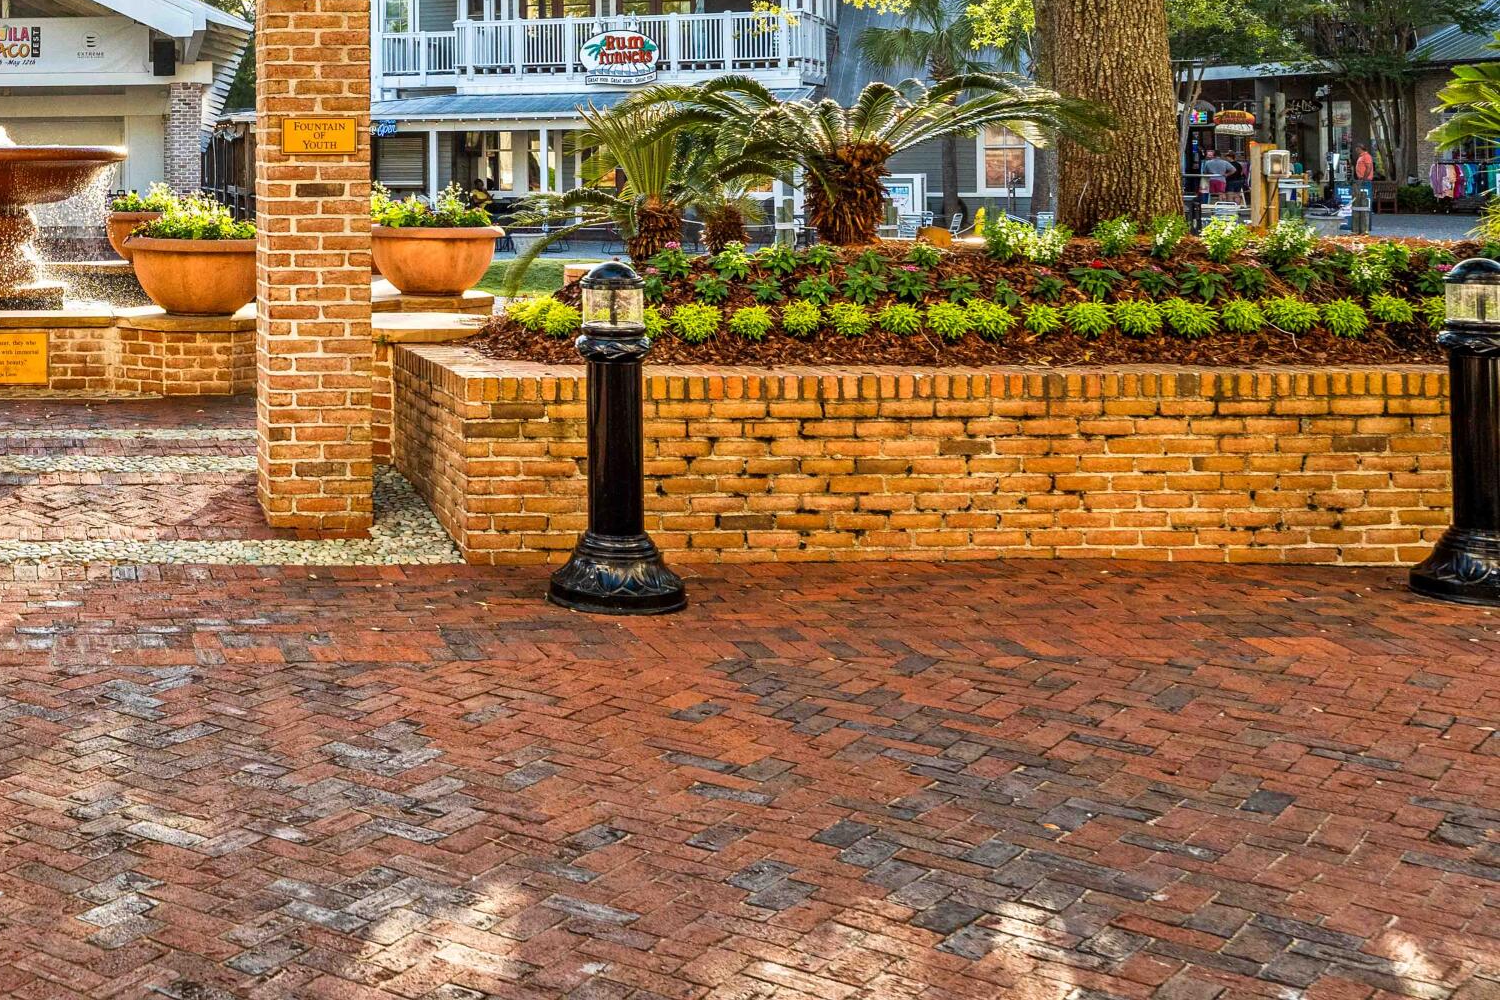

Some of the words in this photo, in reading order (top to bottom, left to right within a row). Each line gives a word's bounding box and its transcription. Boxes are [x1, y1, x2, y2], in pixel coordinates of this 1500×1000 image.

[32, 27, 40, 55] FEST
[294, 121, 346, 131] FOUNTAIN
[313, 132, 326, 140] OF
[302, 140, 337, 150] YOUTH
